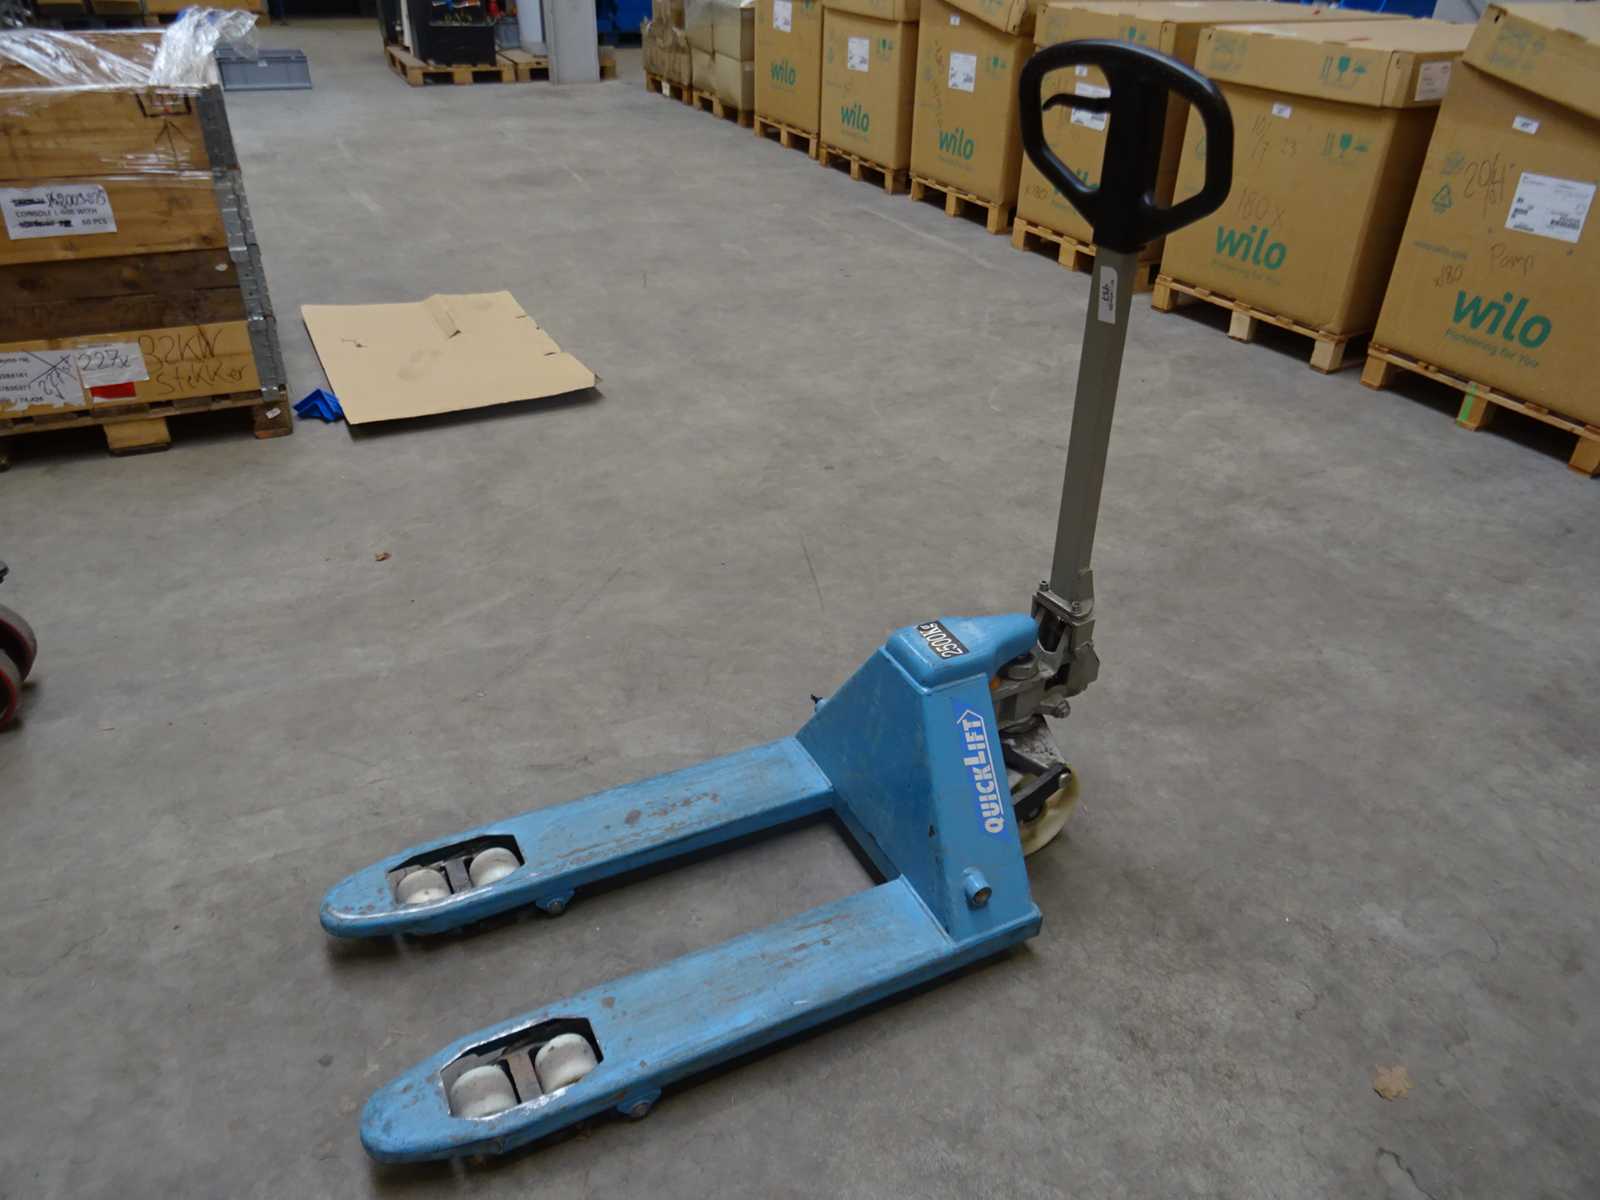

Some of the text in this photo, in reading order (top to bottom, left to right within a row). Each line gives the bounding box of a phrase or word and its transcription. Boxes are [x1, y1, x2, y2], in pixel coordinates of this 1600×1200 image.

[771, 59, 796, 85] wilo
[841, 103, 870, 132] wilo
[939, 128, 975, 160] wilo
[1216, 224, 1287, 270] wilo
[1453, 289, 1552, 349] wilo
